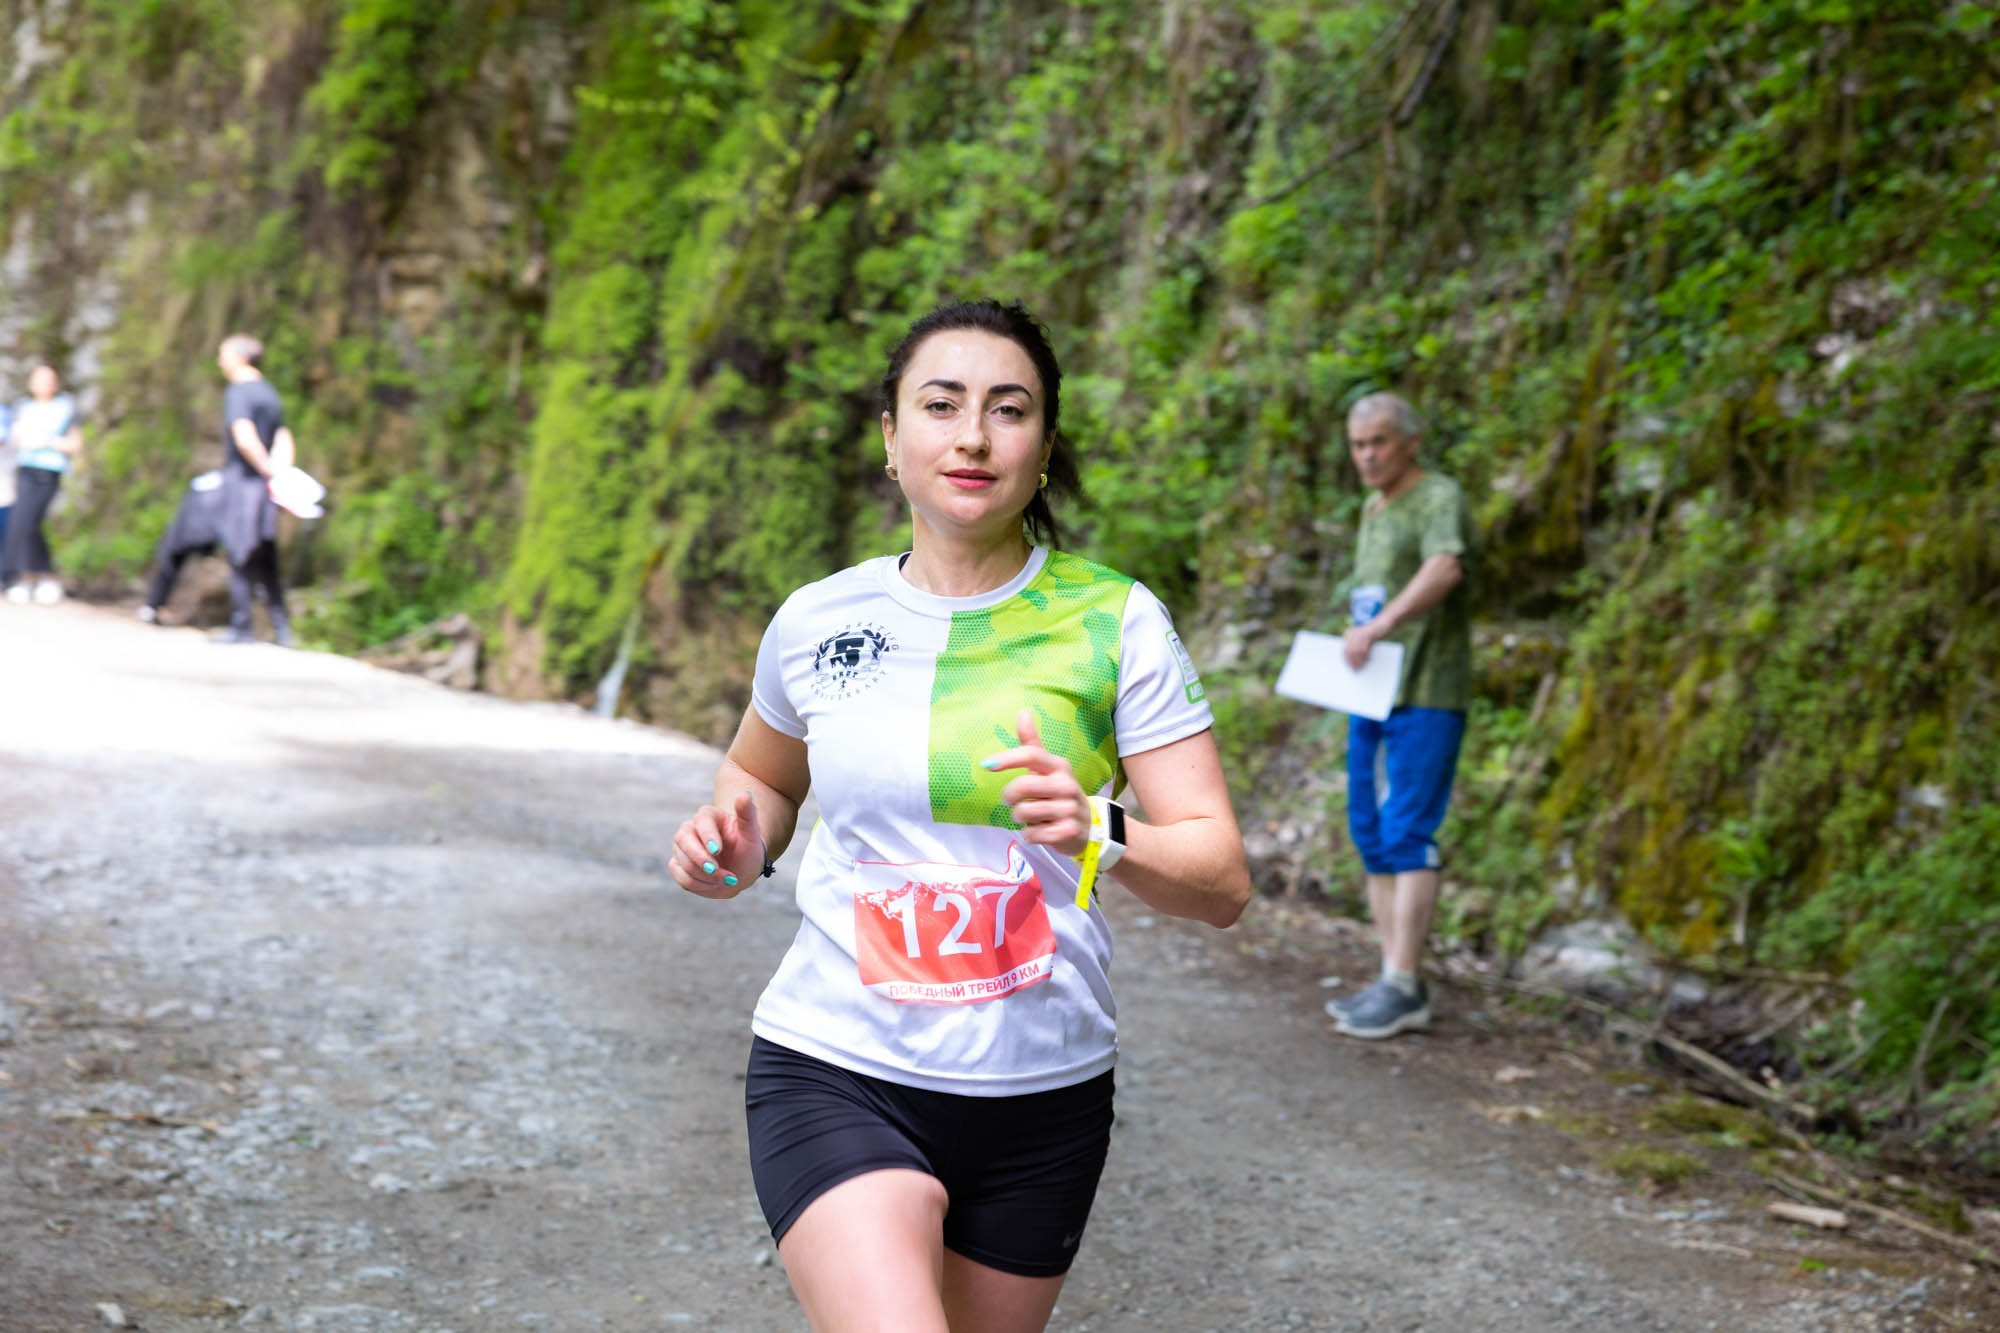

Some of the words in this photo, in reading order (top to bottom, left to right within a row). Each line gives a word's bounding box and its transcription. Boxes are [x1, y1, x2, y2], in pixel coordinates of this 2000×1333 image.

[889, 885, 1019, 958] 127
[889, 983, 965, 998] ПОБЕДНЫЙ
[968, 976, 1010, 995] ТРЕЙЛ
[1011, 972, 1018, 984] 9
